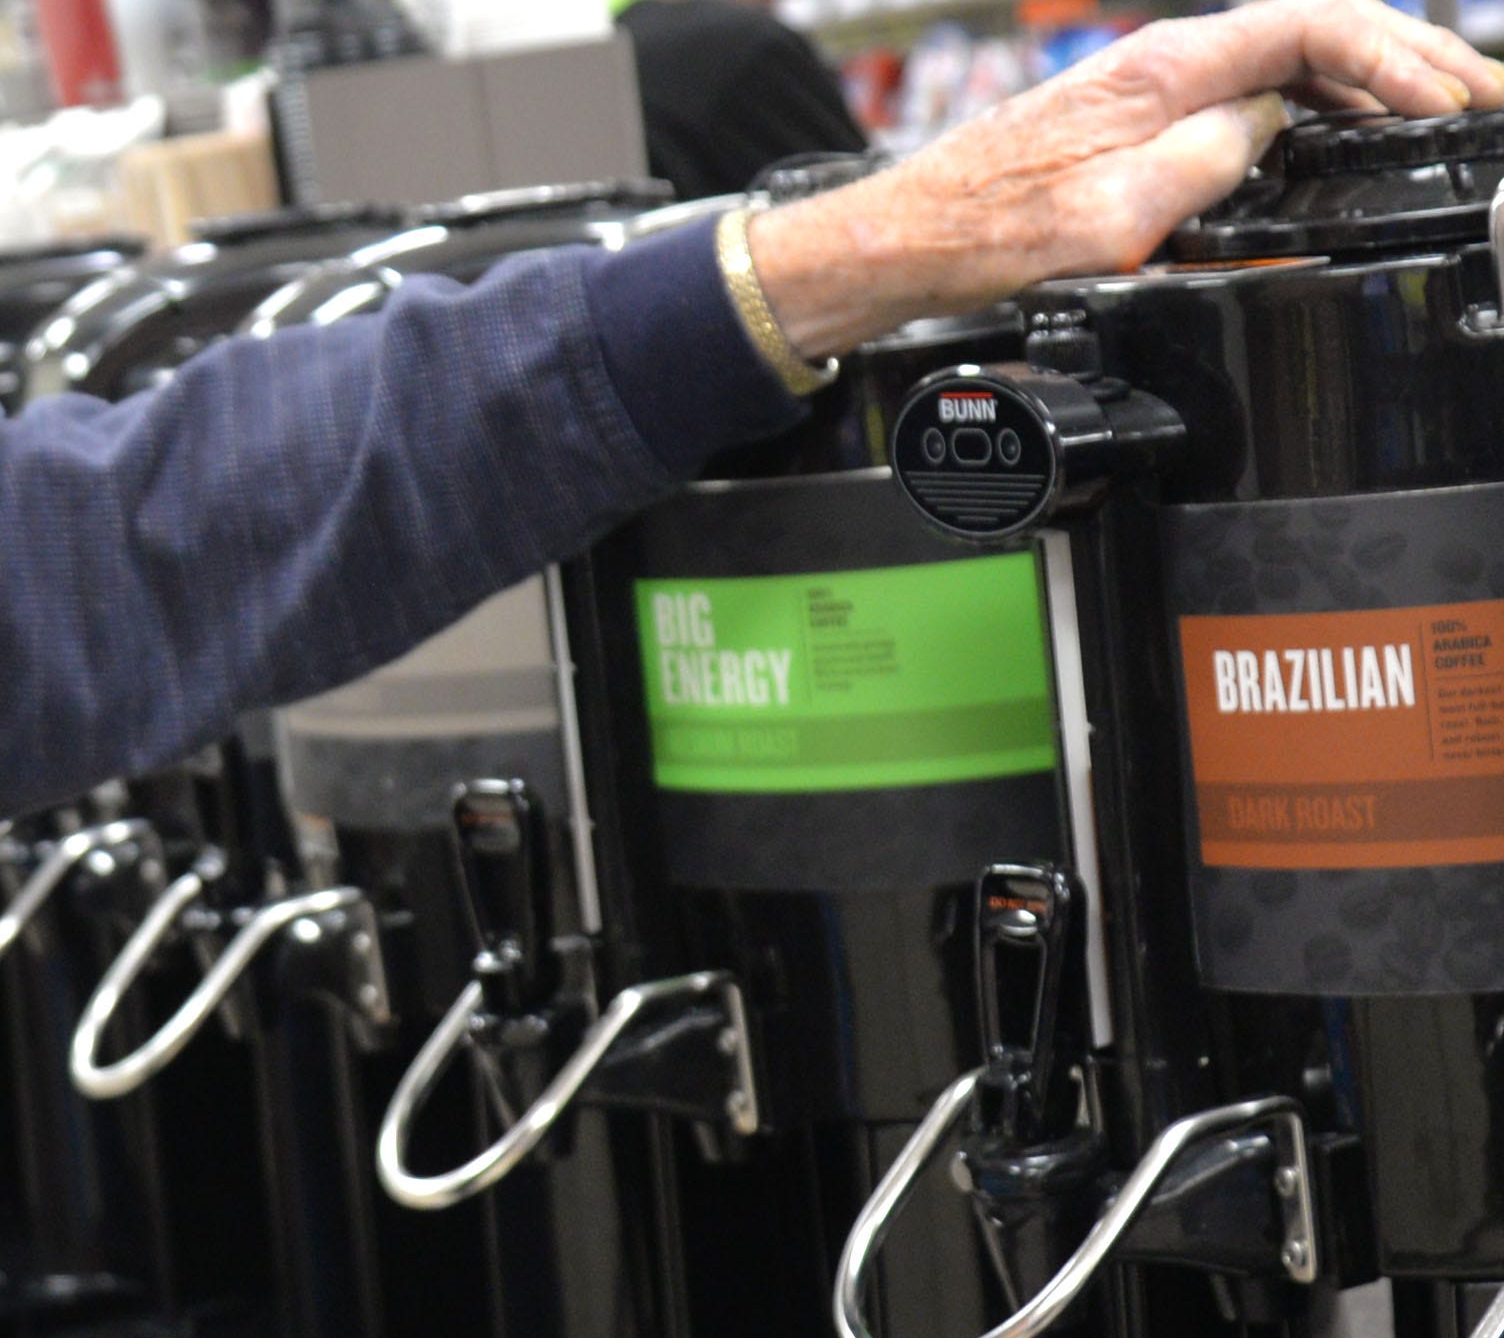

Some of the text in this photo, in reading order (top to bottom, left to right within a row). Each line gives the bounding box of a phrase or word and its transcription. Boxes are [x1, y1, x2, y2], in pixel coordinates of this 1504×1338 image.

[939, 398, 997, 423] BUNN
[652, 591, 715, 647] BIG
[1433, 635, 1492, 652] ARABICA
[1434, 653, 1485, 670] COFFEE
[661, 646, 794, 707] ENERGY
[1213, 643, 1417, 713] BRAZILIAN
[1225, 794, 1379, 832] DARK ROAST
